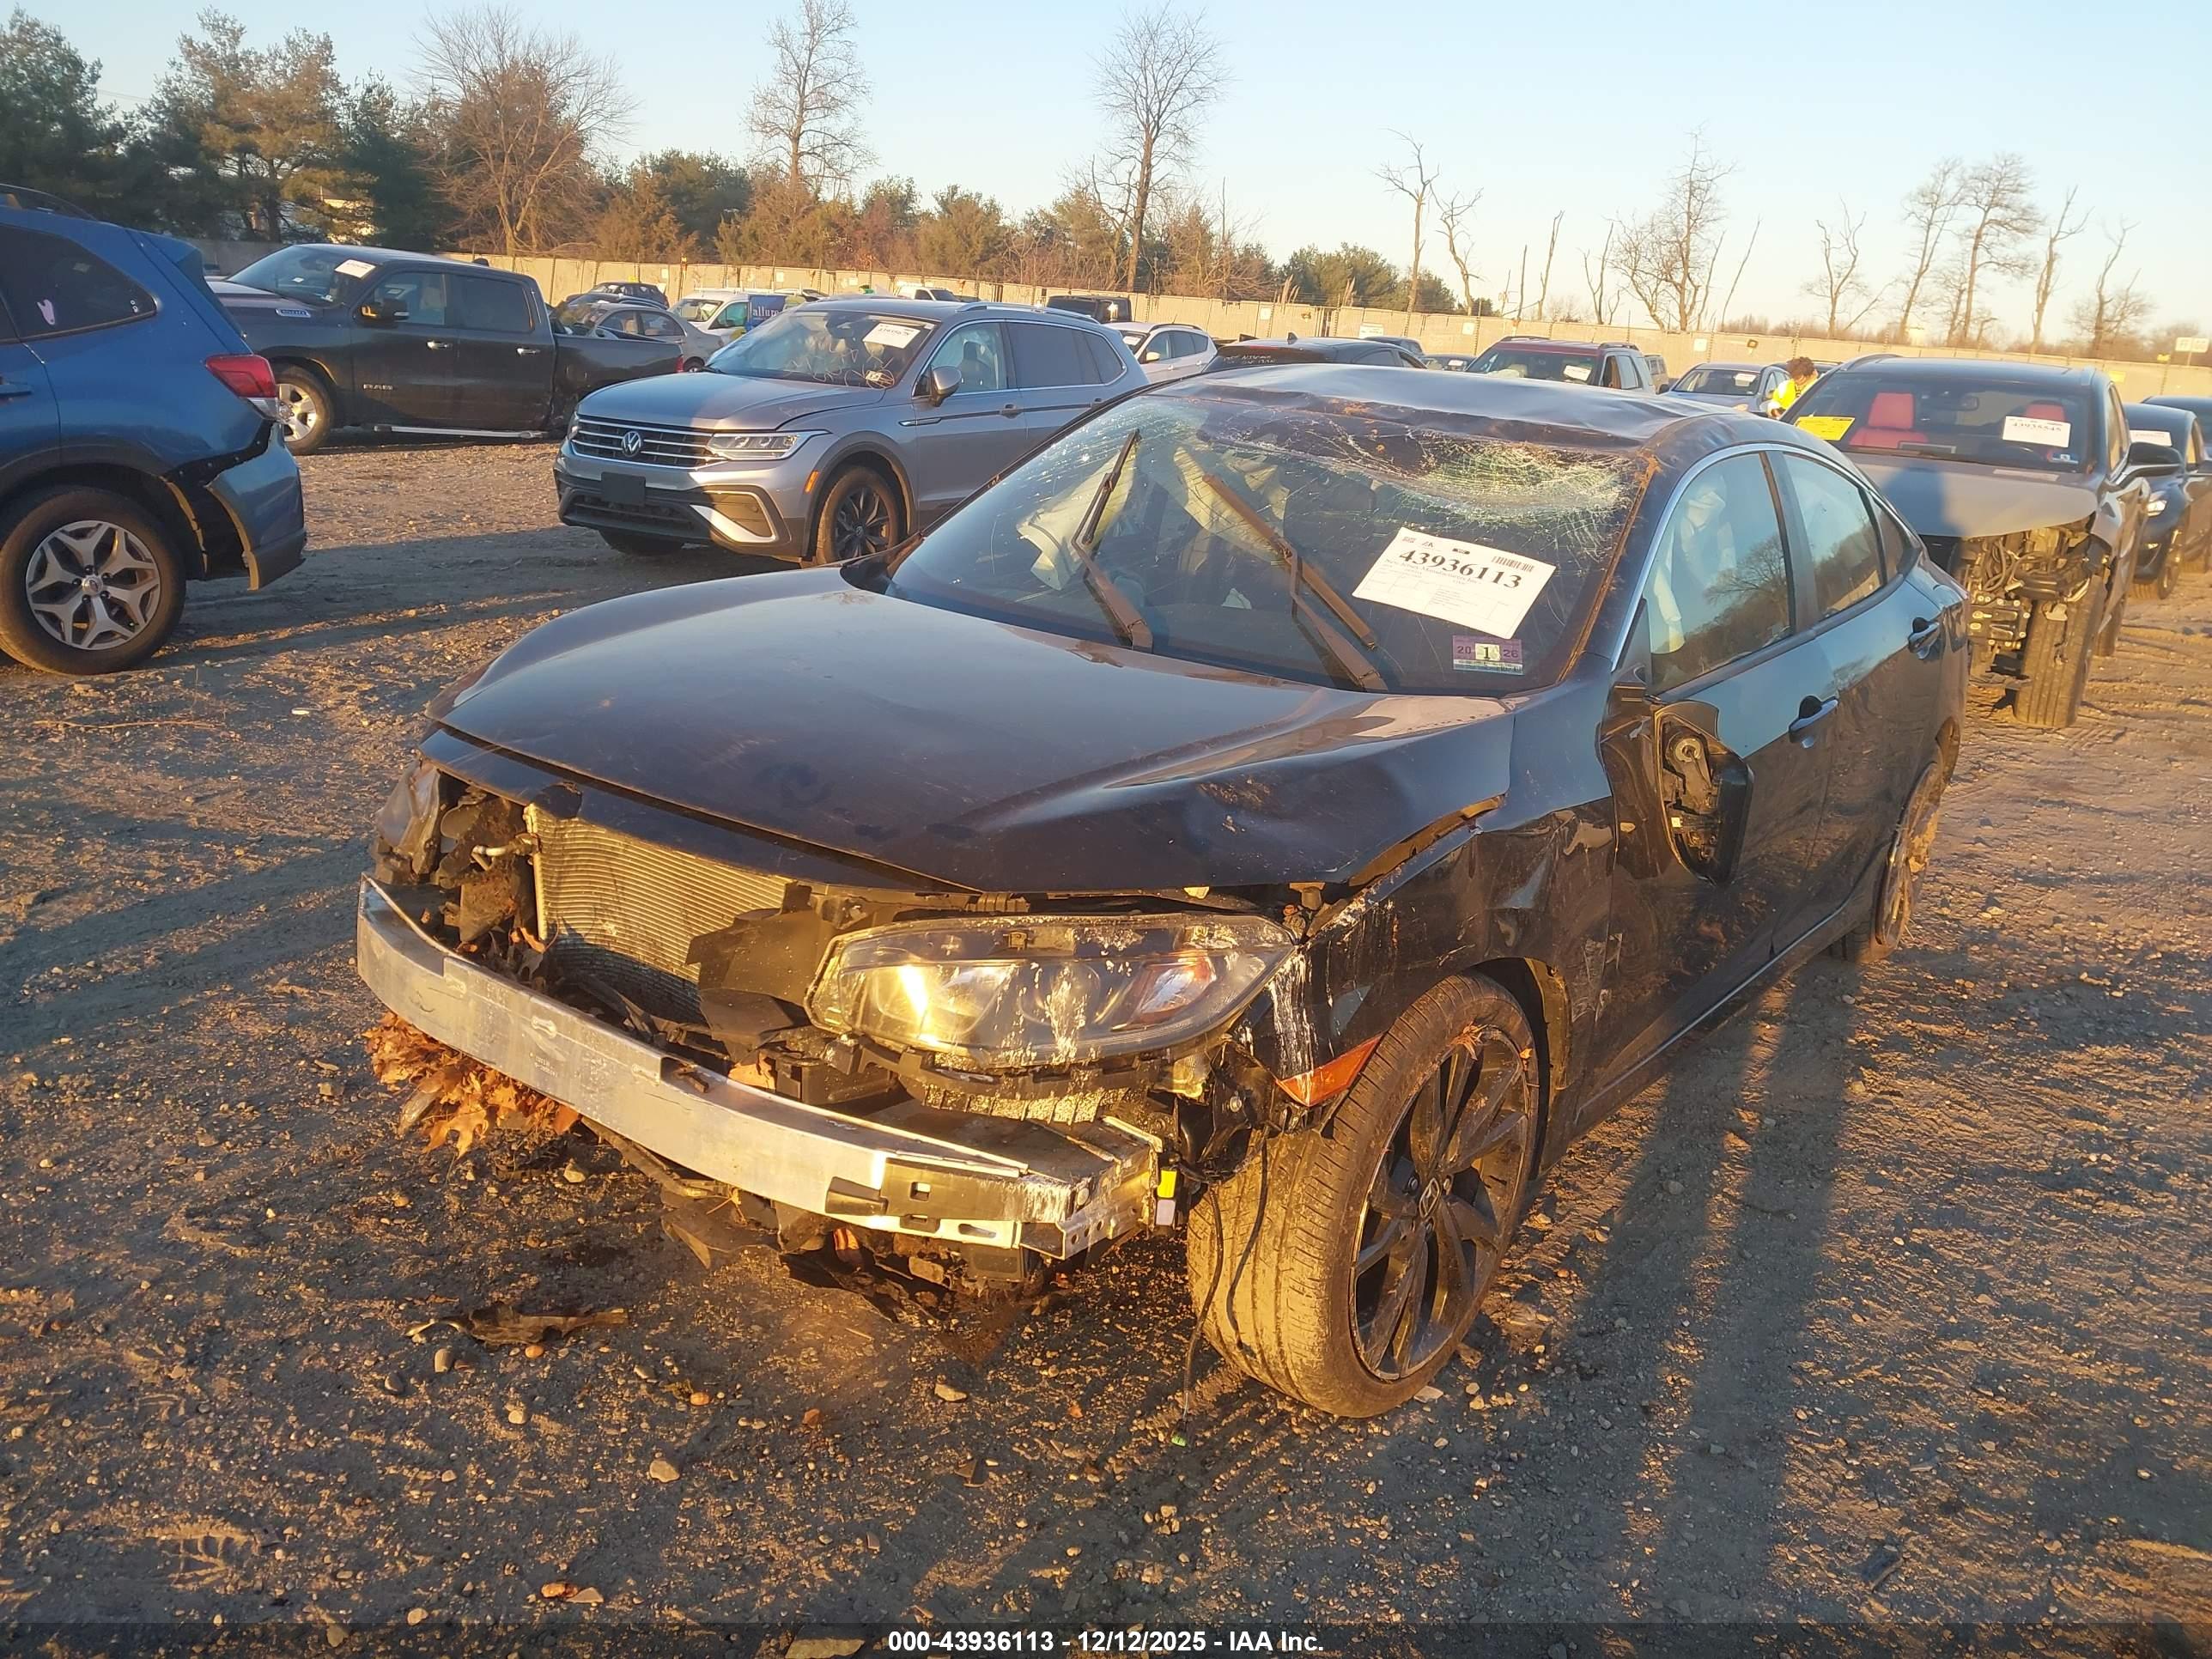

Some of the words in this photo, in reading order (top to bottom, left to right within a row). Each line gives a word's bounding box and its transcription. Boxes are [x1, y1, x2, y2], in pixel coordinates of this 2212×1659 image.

[1399, 550, 1522, 588] 43936113
[1457, 646, 1472, 654] 20
[1484, 647, 1490, 660] 1
[1503, 649, 1519, 658] 26
